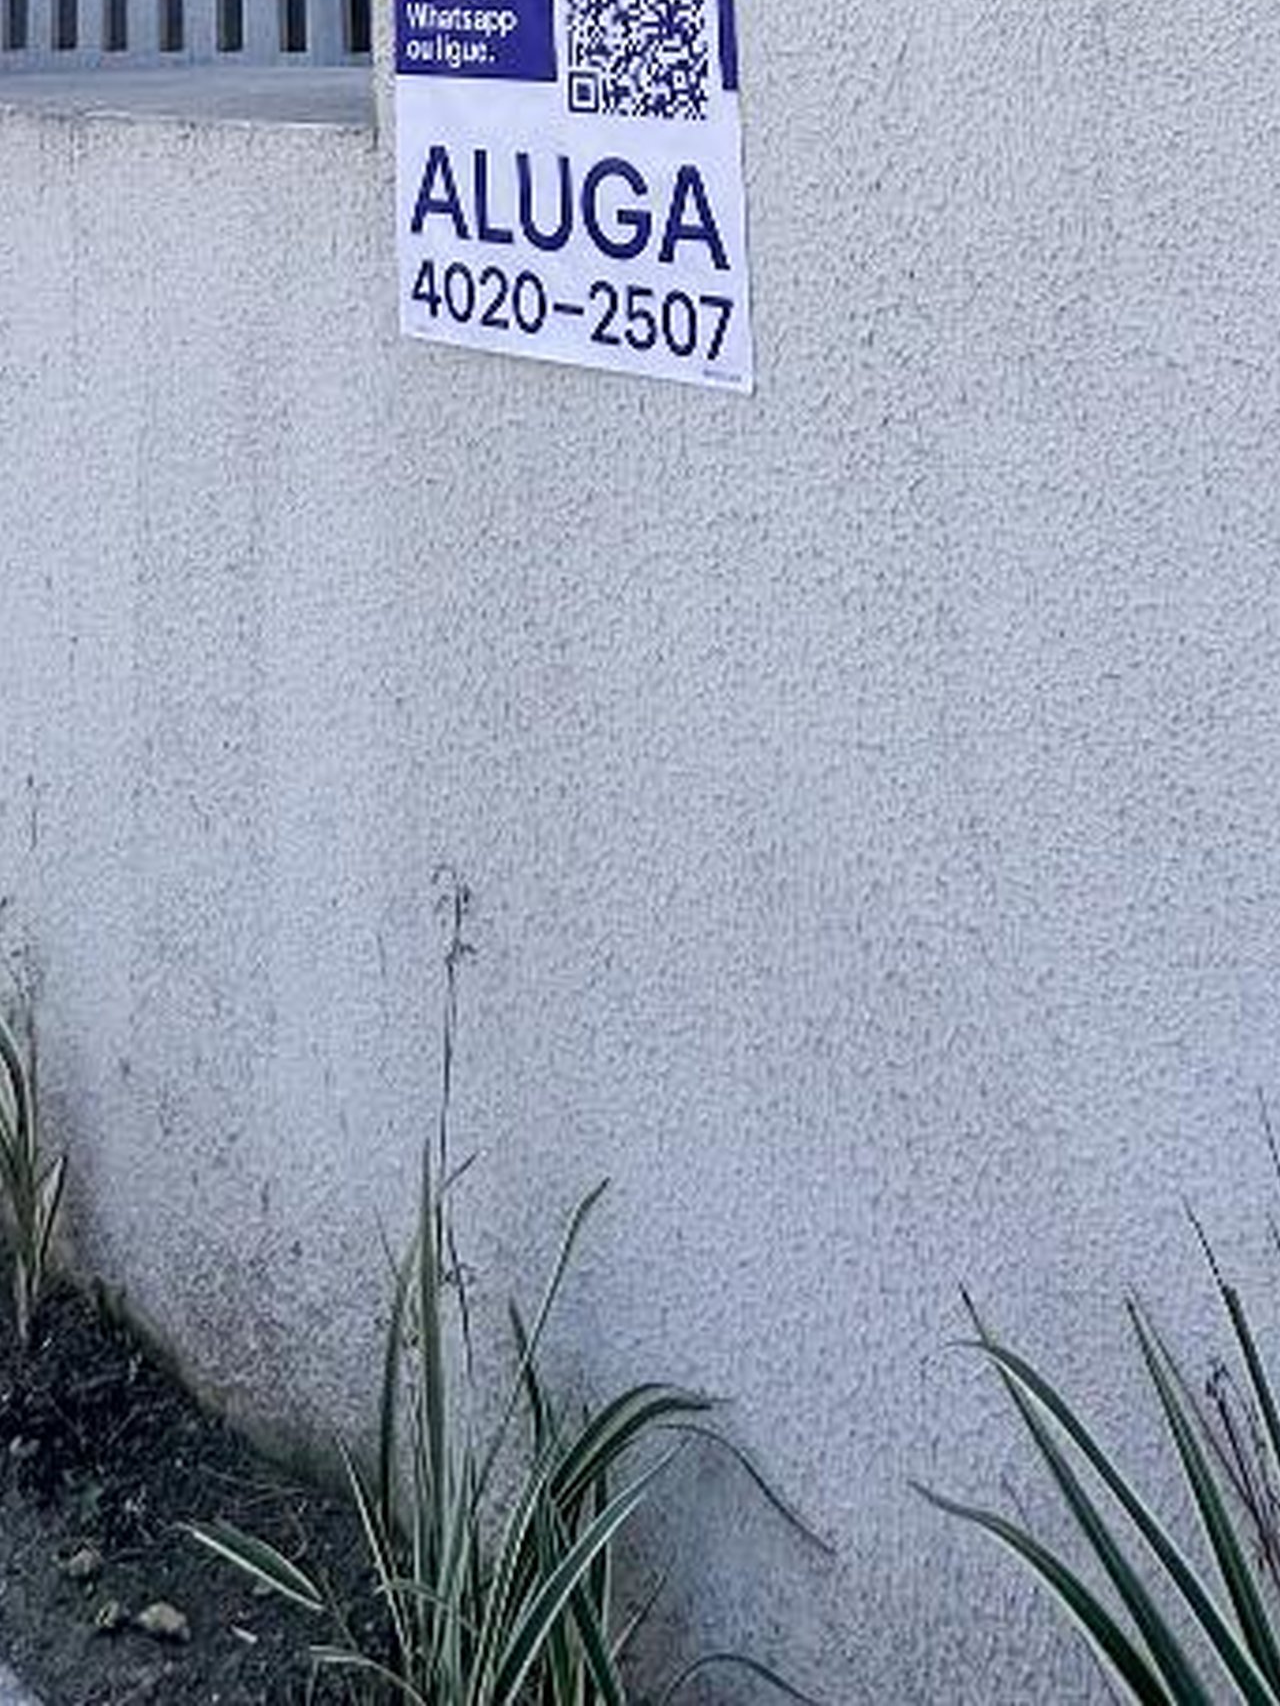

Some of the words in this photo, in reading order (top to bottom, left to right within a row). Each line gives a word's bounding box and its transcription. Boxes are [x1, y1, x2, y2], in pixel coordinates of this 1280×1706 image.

[406, 2, 518, 38] Whatsapp
[406, 39, 434, 61] ou
[437, 33, 496, 68] ligue.
[410, 145, 732, 271] ALUGA
[410, 259, 735, 361] 4020-2507
